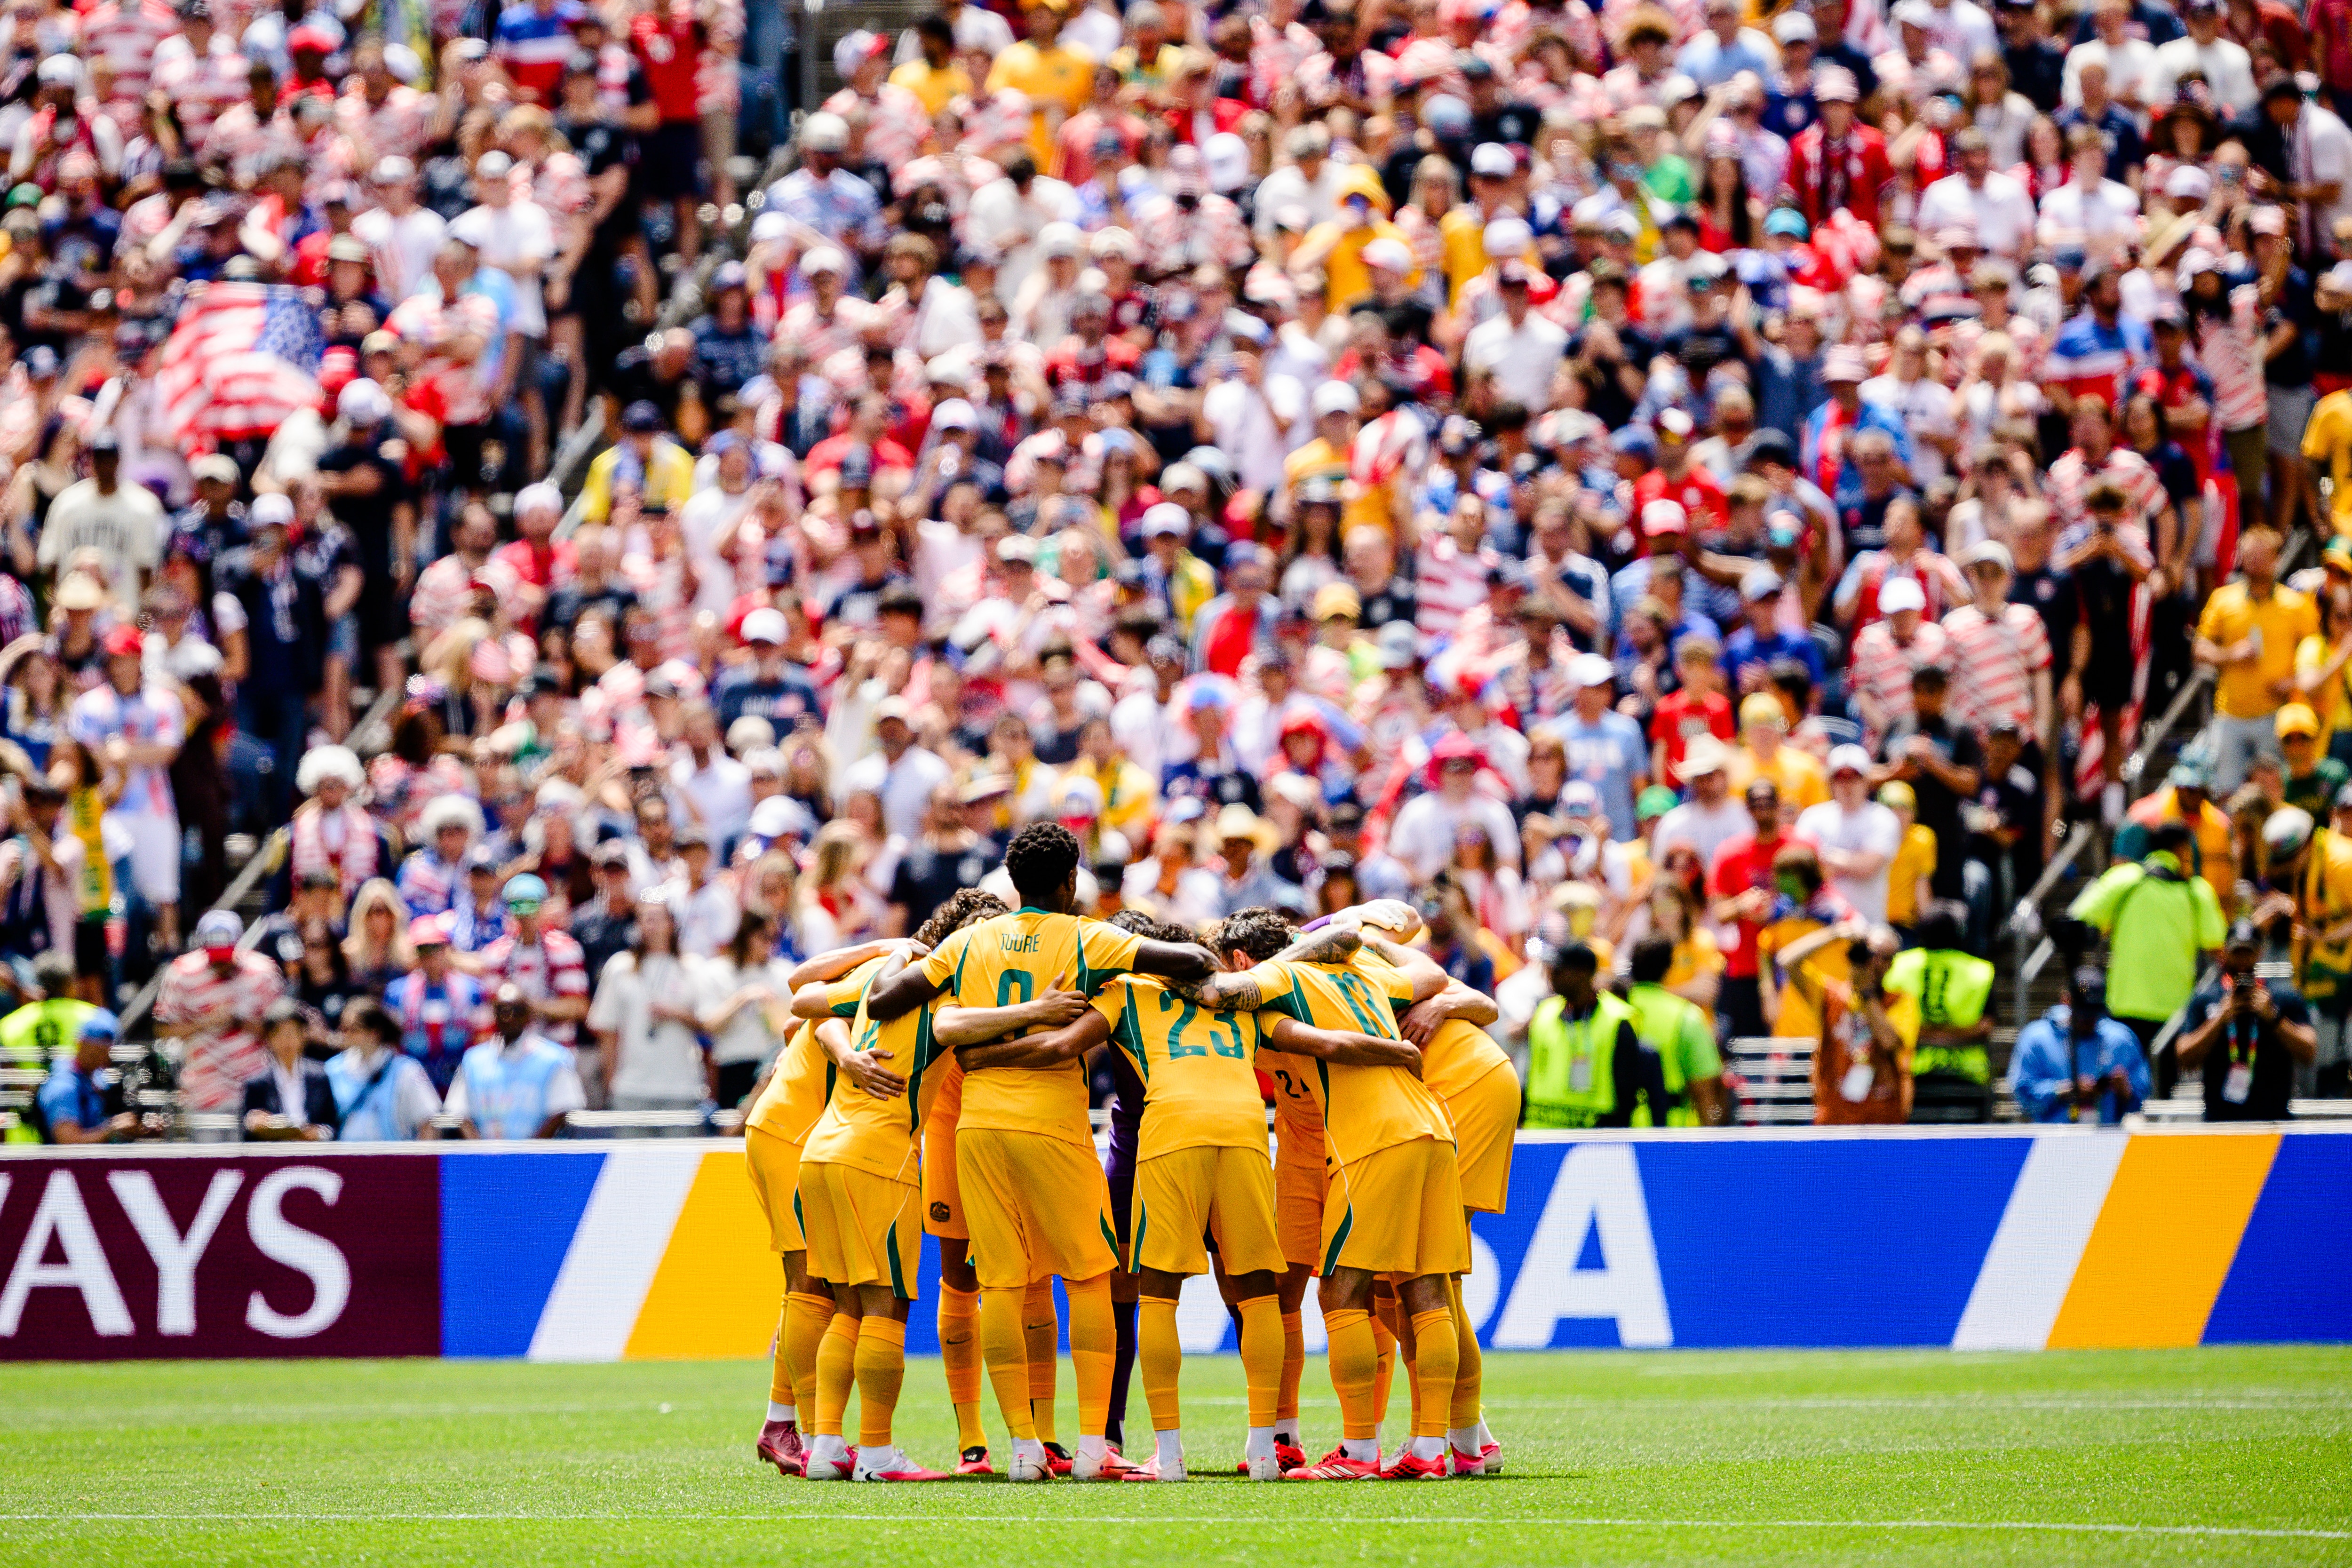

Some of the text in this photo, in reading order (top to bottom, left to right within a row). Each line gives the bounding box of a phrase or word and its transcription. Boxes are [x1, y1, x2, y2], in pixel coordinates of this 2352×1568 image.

[1001, 933, 1041, 953] TOURE
[1159, 989, 1245, 1060] 23
[0, 1165, 352, 1338] AYS
